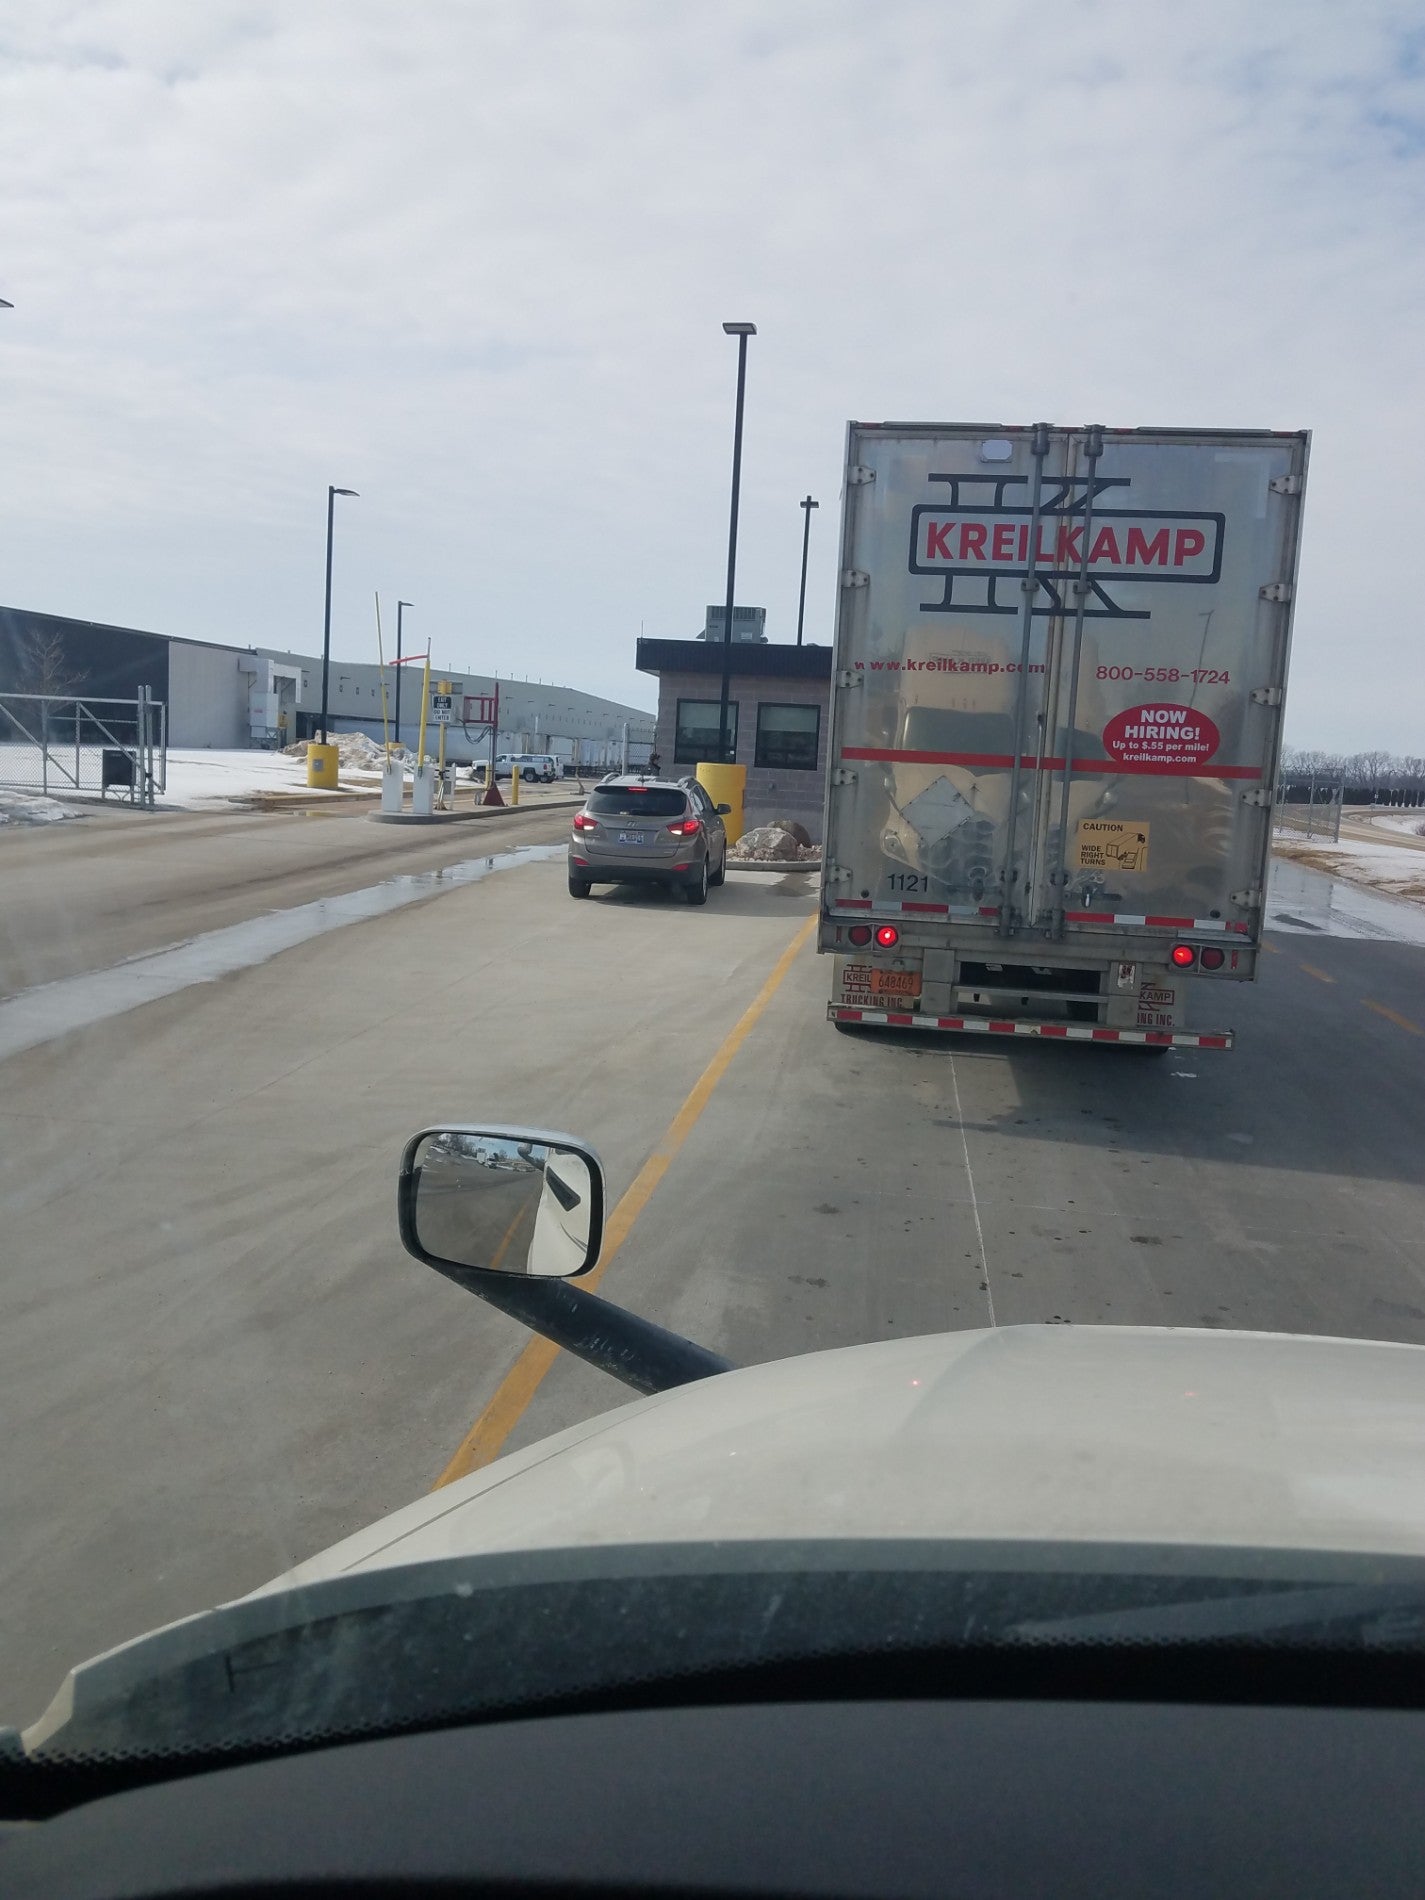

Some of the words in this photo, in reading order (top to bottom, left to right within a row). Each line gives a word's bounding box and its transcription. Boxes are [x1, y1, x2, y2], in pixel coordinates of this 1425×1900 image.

[926, 521, 1205, 567] KREILKAMP
[1096, 665, 1231, 685] 800-558-1724
[1140, 709, 1187, 724] NOW
[1124, 725, 1201, 740] HIRING!
[1112, 740, 1126, 751] Up
[1129, 741, 1139, 750] to
[1141, 741, 1164, 751] $.55
[1165, 743, 1182, 752] per
[1184, 743, 1210, 752] mile!
[1122, 753, 1197, 764] kreilkamp.com
[1082, 822, 1124, 832] CAUTION
[1081, 844, 1102, 852] WIDE
[1080, 851, 1105, 859] RIGHT
[1080, 858, 1106, 866] TURNS
[887, 873, 928, 893] 1121
[841, 993, 885, 1007] TRUCKING
[1140, 991, 1171, 1002] KAMP
[1155, 1013, 1176, 1027] INC.
